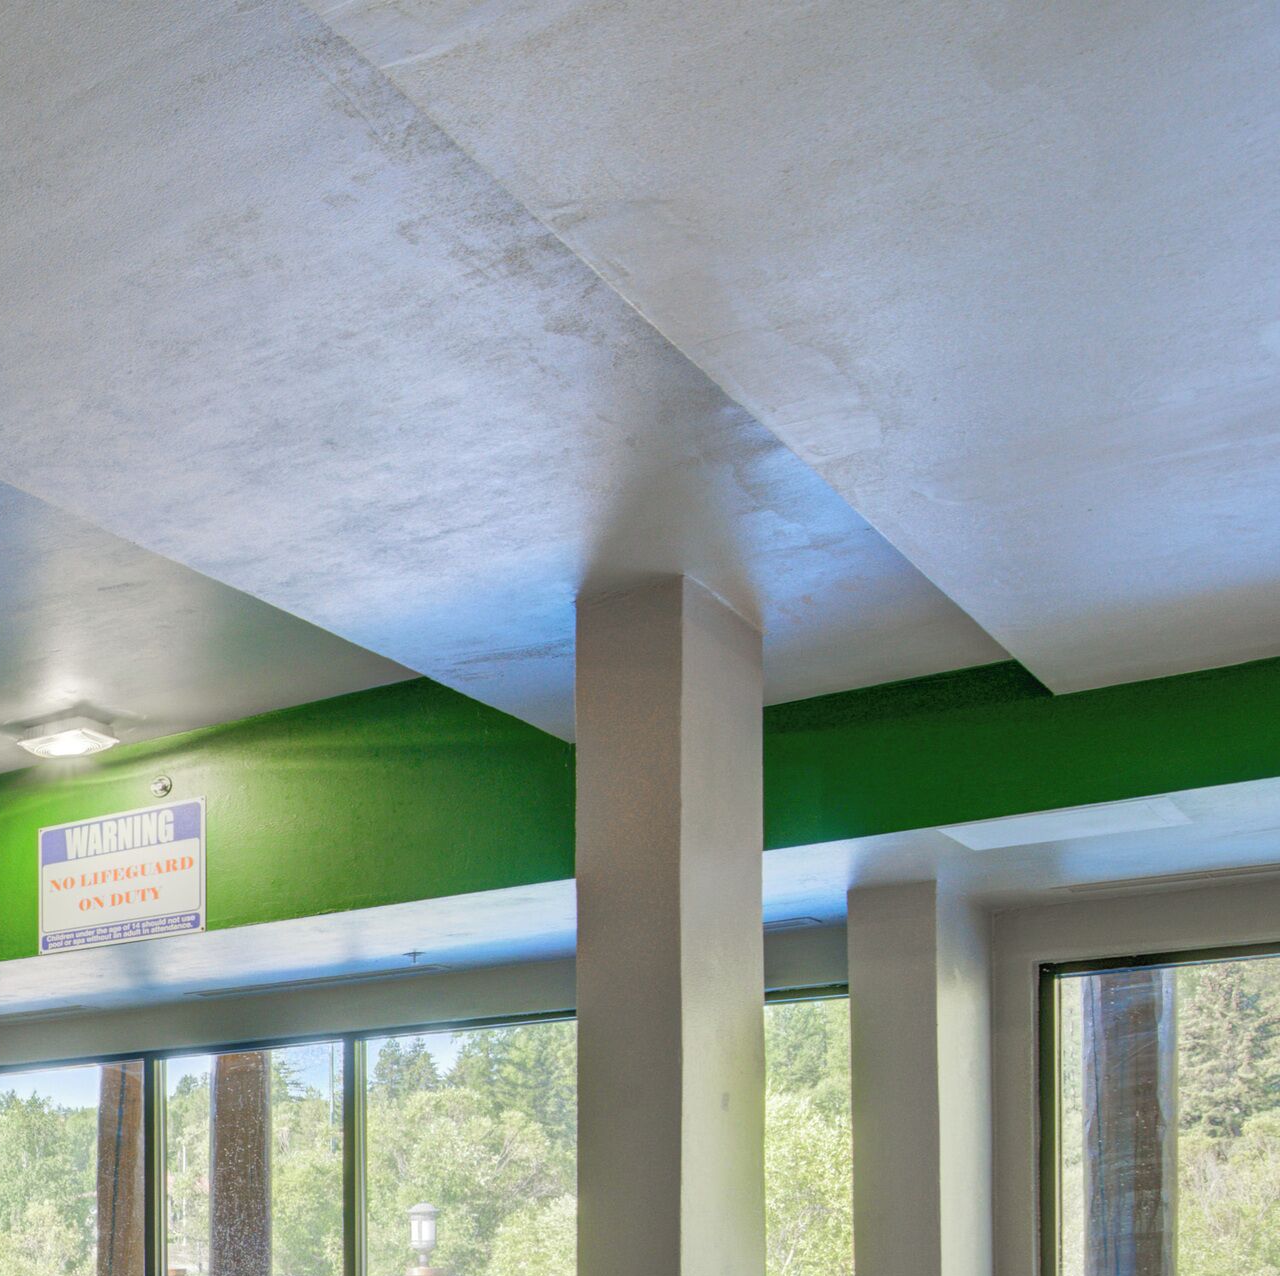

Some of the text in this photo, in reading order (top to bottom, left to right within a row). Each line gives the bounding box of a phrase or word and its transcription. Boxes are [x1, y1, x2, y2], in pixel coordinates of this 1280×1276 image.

[65, 809, 174, 860] WARNING
[50, 856, 194, 892] NO LIFEGUARD
[79, 886, 162, 912] ON DUTY
[46, 933, 75, 942] Children
[75, 929, 95, 938] under
[108, 926, 122, 934] age
[142, 919, 166, 928] should
[48, 941, 63, 949] pool
[86, 934, 111, 942] without
[122, 929, 141, 937] adult
